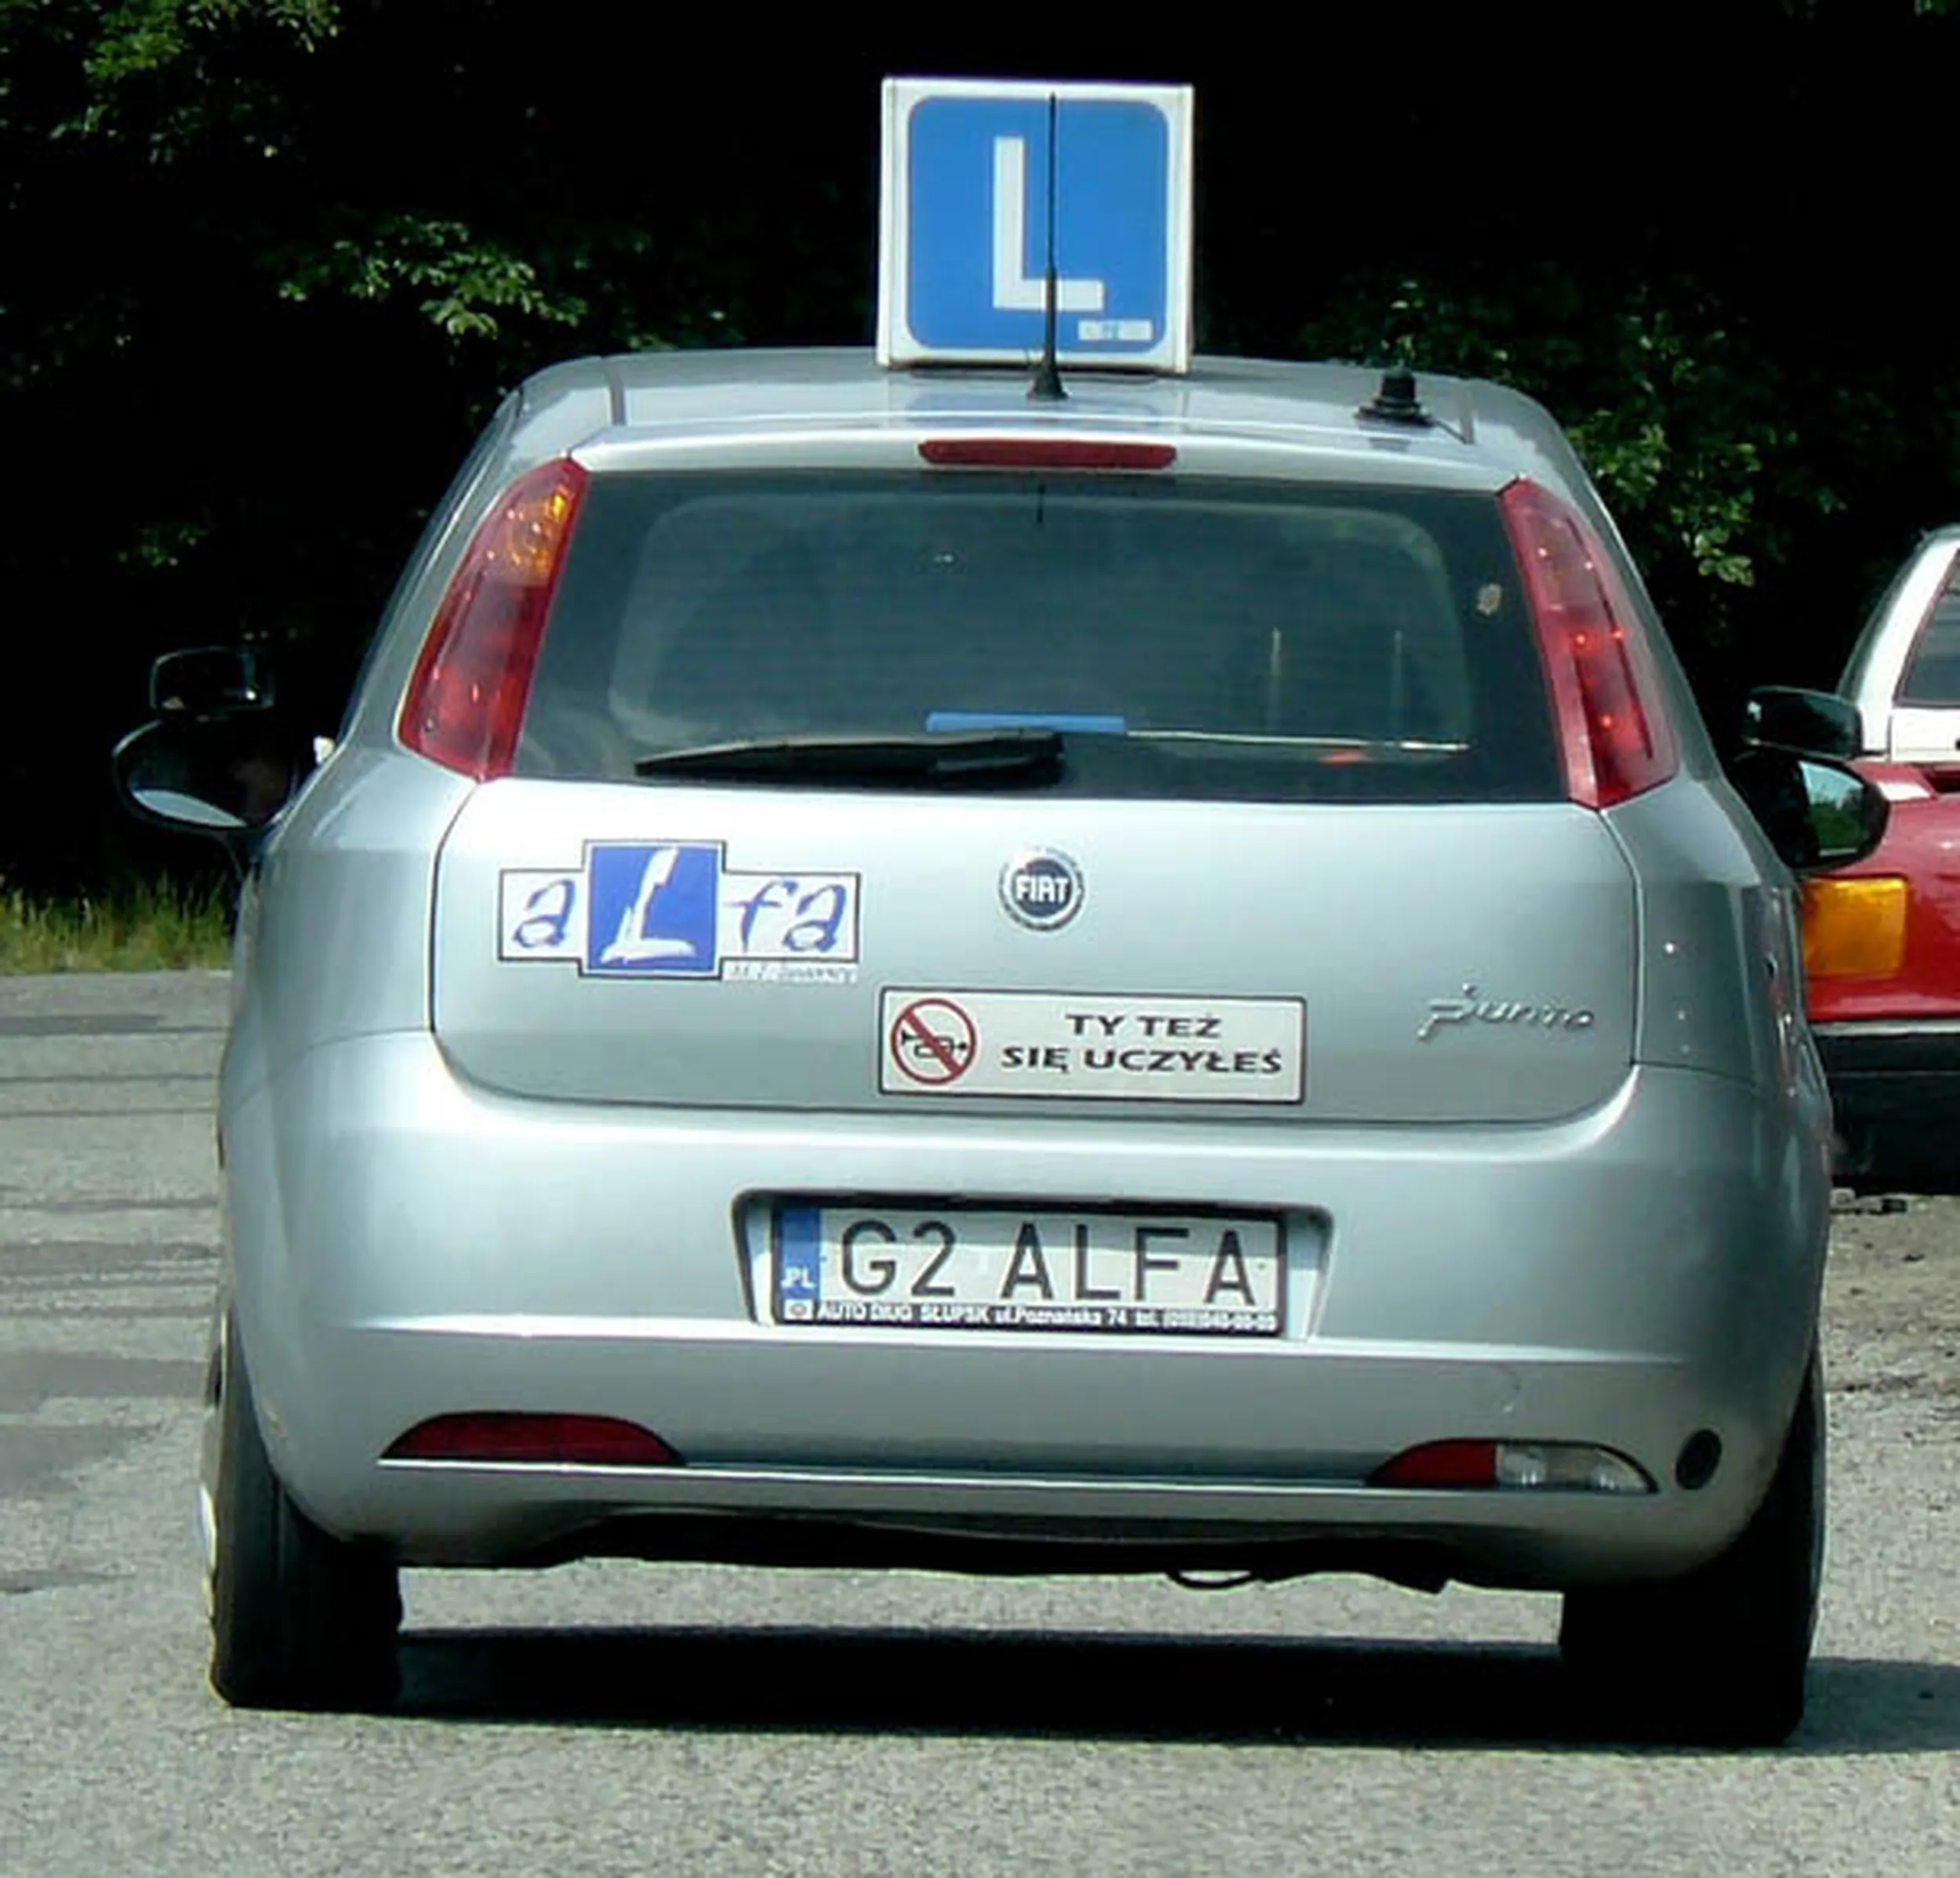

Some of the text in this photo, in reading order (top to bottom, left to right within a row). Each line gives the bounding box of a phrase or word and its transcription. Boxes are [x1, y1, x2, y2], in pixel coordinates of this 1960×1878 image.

[993, 136, 1104, 311] L
[1016, 874, 1069, 903] FIAT
[1066, 1012, 1221, 1039] TY TEŻ
[1002, 1046, 1282, 1074] SIĘ UCZYŁEŚ
[840, 1220, 1256, 1306] G2 ALFA
[782, 1267, 815, 1289] PL
[817, 1300, 866, 1321] AUTO
